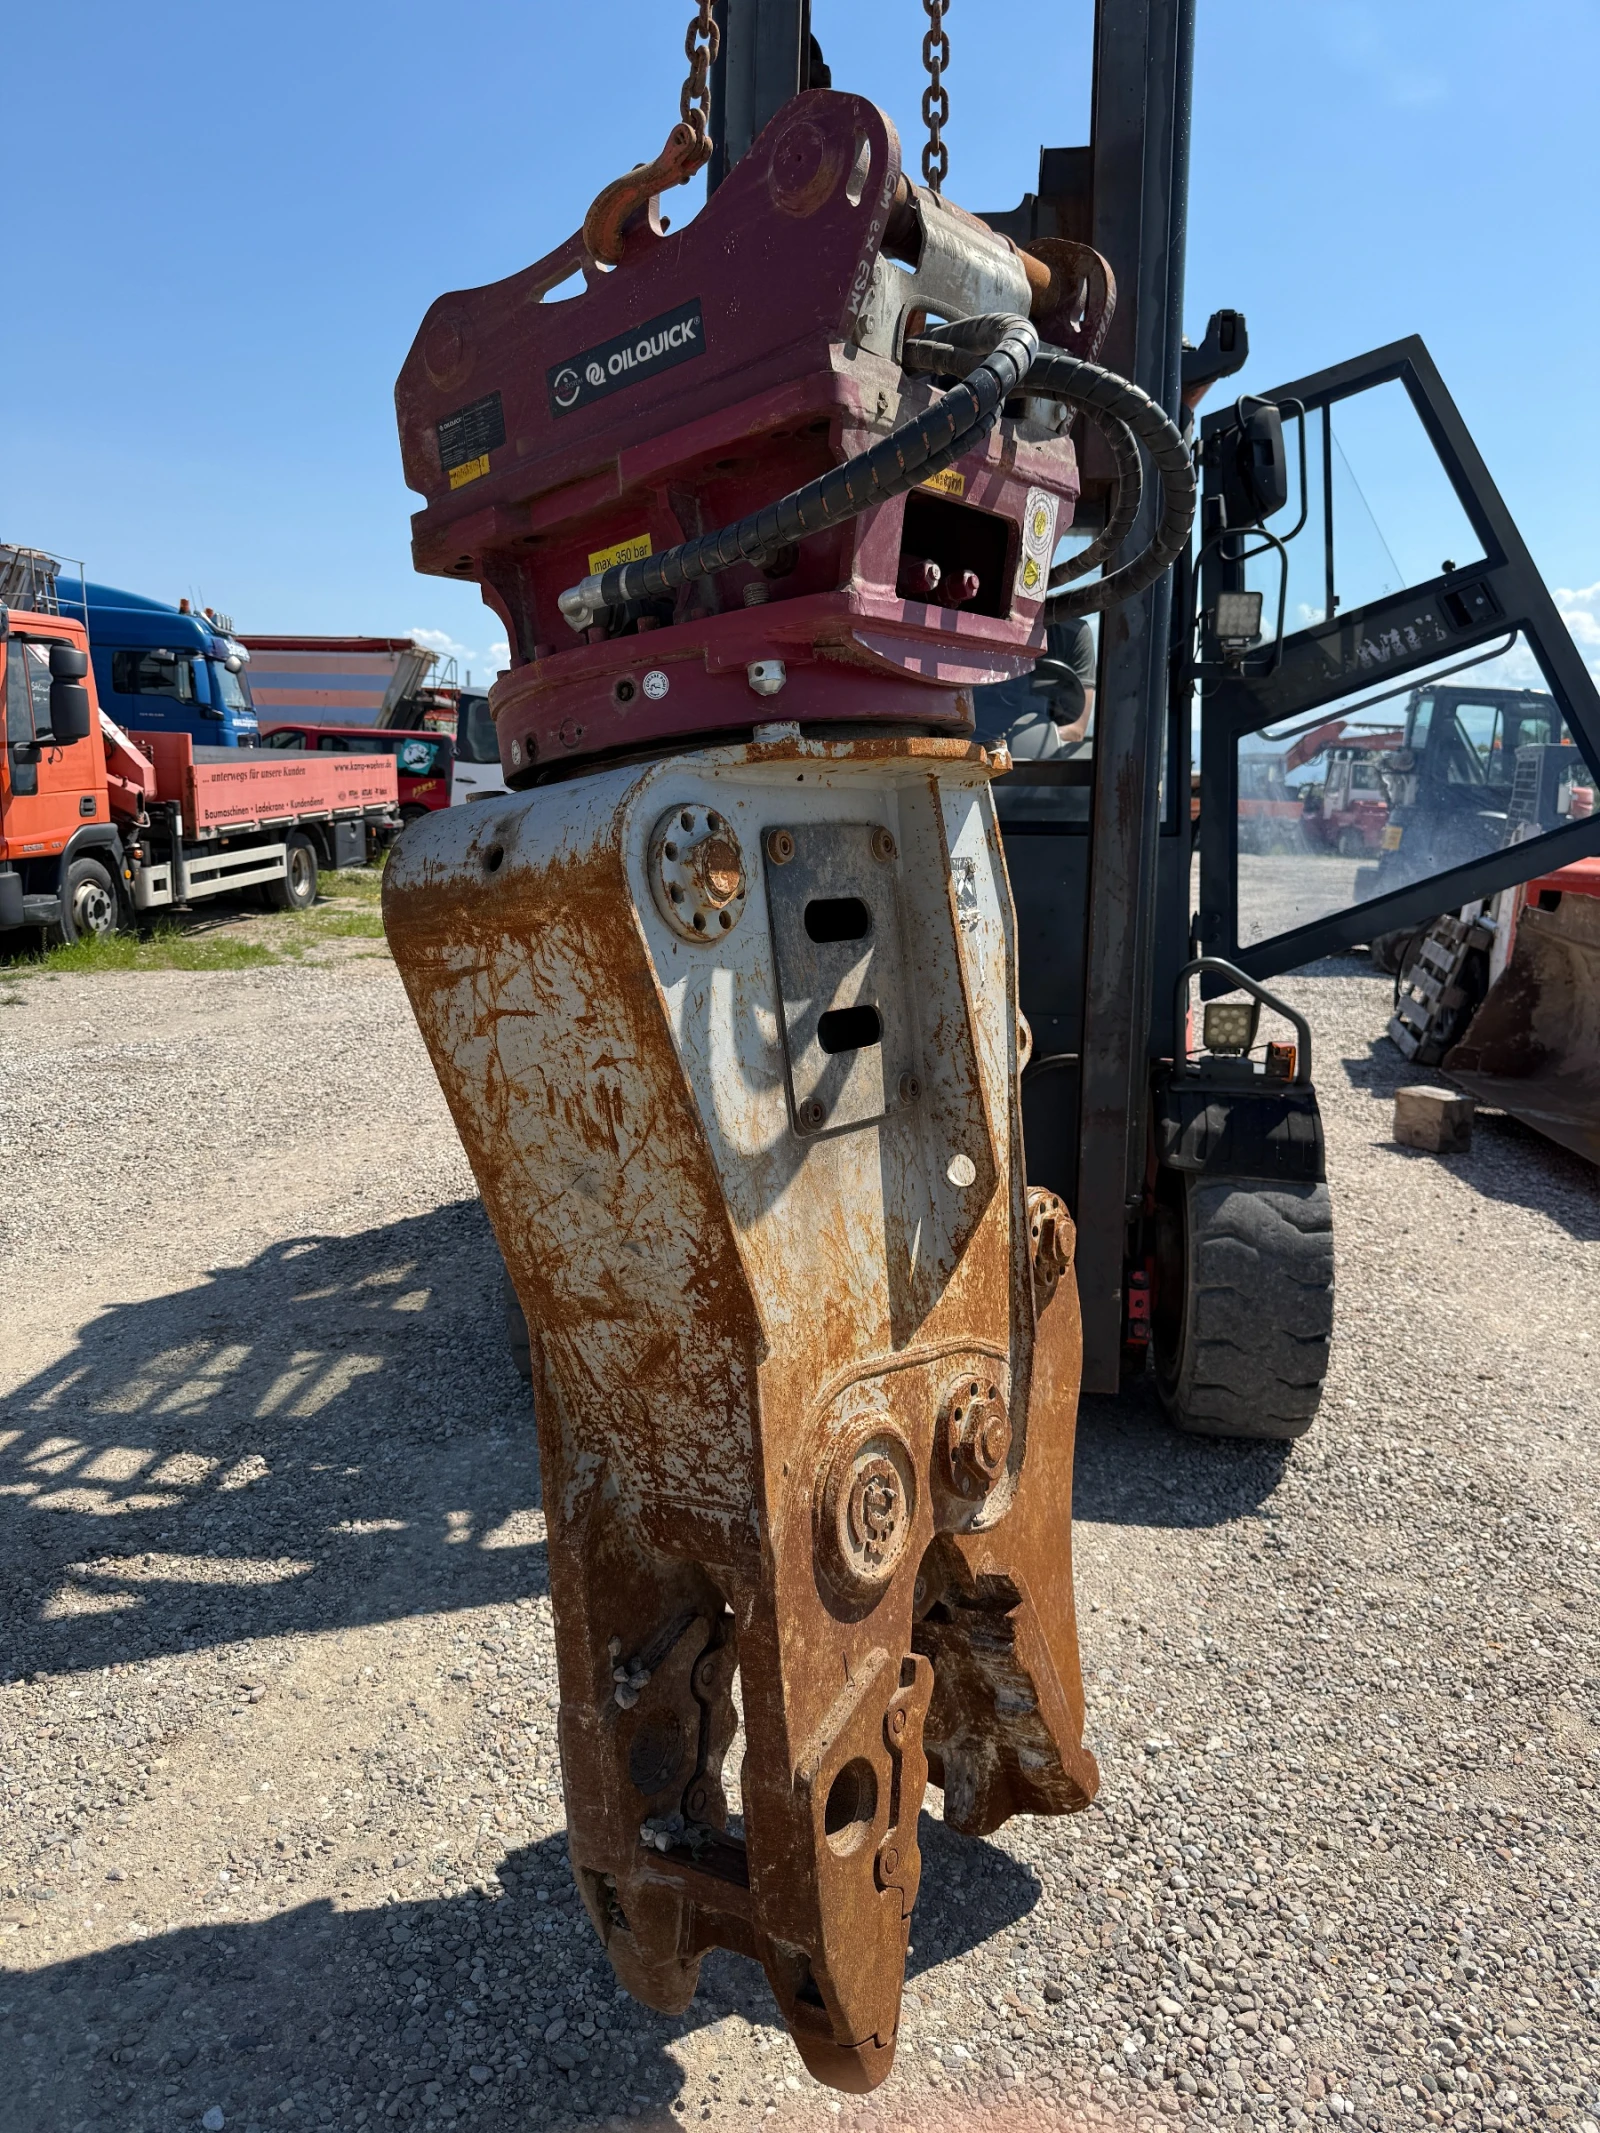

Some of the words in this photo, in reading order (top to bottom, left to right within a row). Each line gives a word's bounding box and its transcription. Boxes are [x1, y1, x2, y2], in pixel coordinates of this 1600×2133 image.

[616, 547, 632, 565] 350
[634, 545, 648, 559] bar
[211, 771, 248, 783] unterwegs
[249, 768, 260, 779] für
[261, 769, 281, 779] unsere
[283, 765, 306, 777] Kunden
[204, 805, 250, 820] Baumaschinen
[255, 801, 285, 814] Ladekrane
[290, 796, 325, 809] Kundendienst
